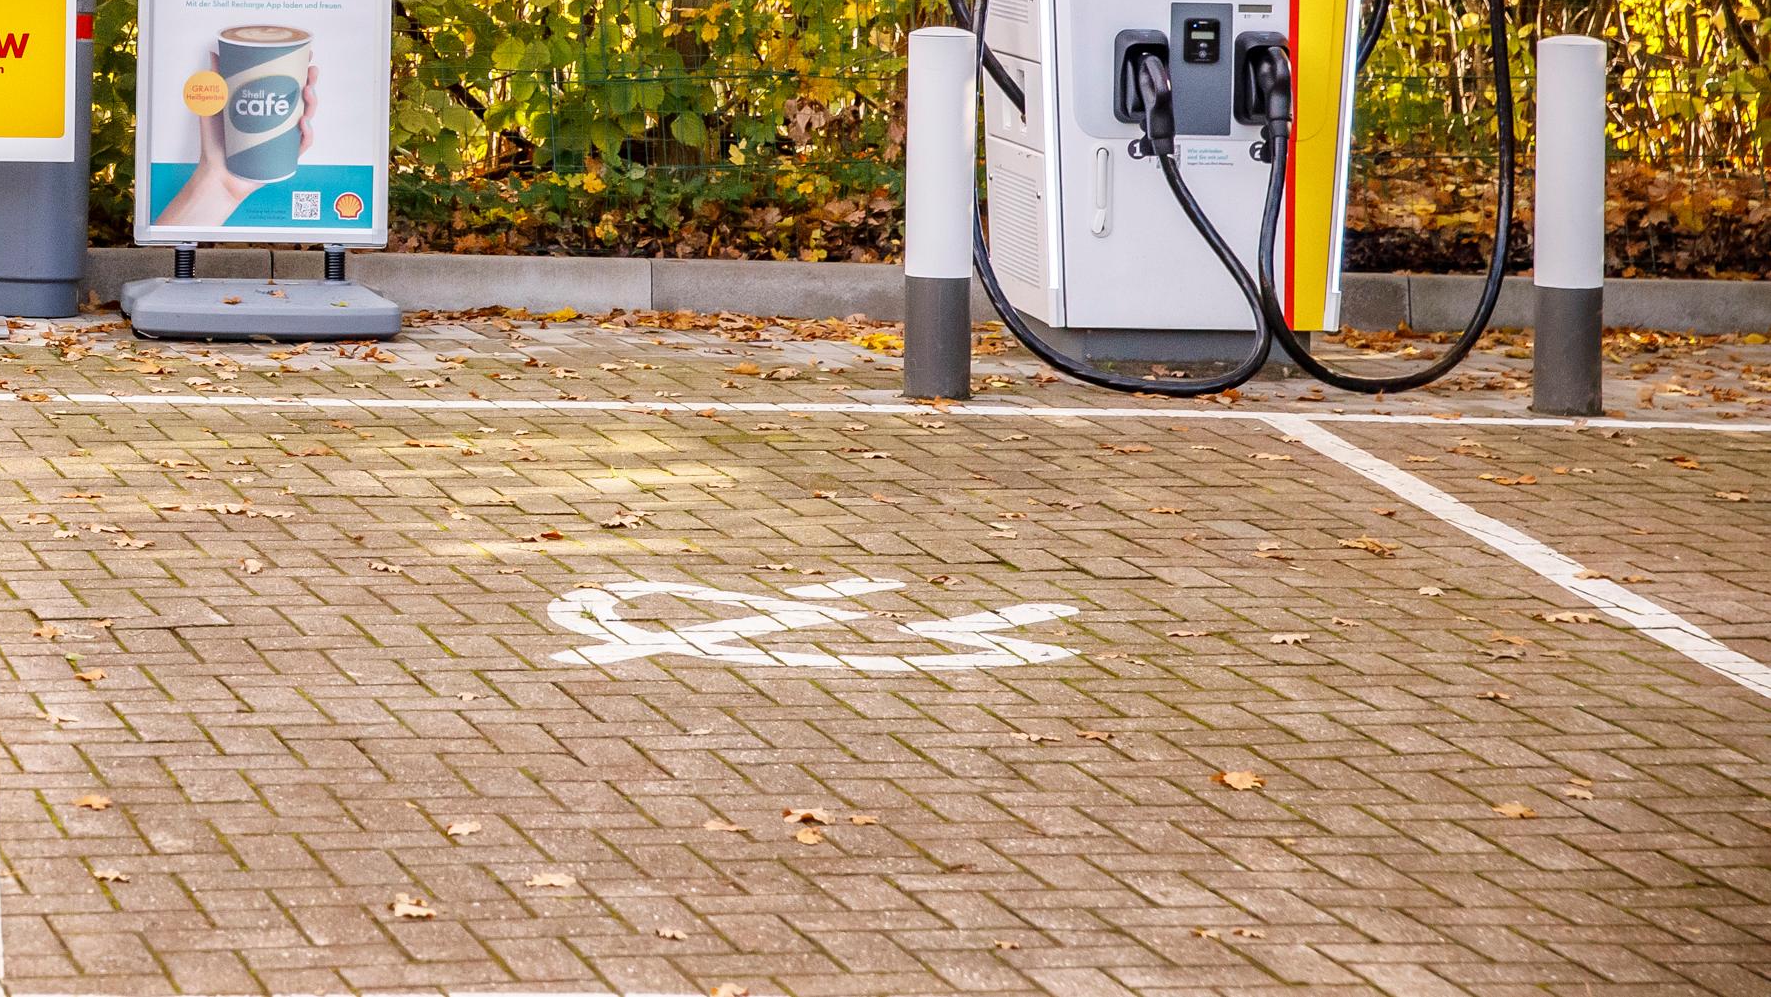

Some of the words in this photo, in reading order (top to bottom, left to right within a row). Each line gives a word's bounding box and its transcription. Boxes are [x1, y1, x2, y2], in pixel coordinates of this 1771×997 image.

[185, 0, 198, 8] Mit
[198, 0, 211, 8] der
[212, 0, 230, 8] Shell
[231, 0, 265, 10] Recharge
[266, 1, 282, 11] App
[282, 0, 303, 9] laden
[304, 0, 318, 9] und
[191, 85, 220, 93] GRATIS
[241, 89, 265, 100] Shell
[235, 92, 290, 117] café
[1133, 142, 1143, 157] 1
